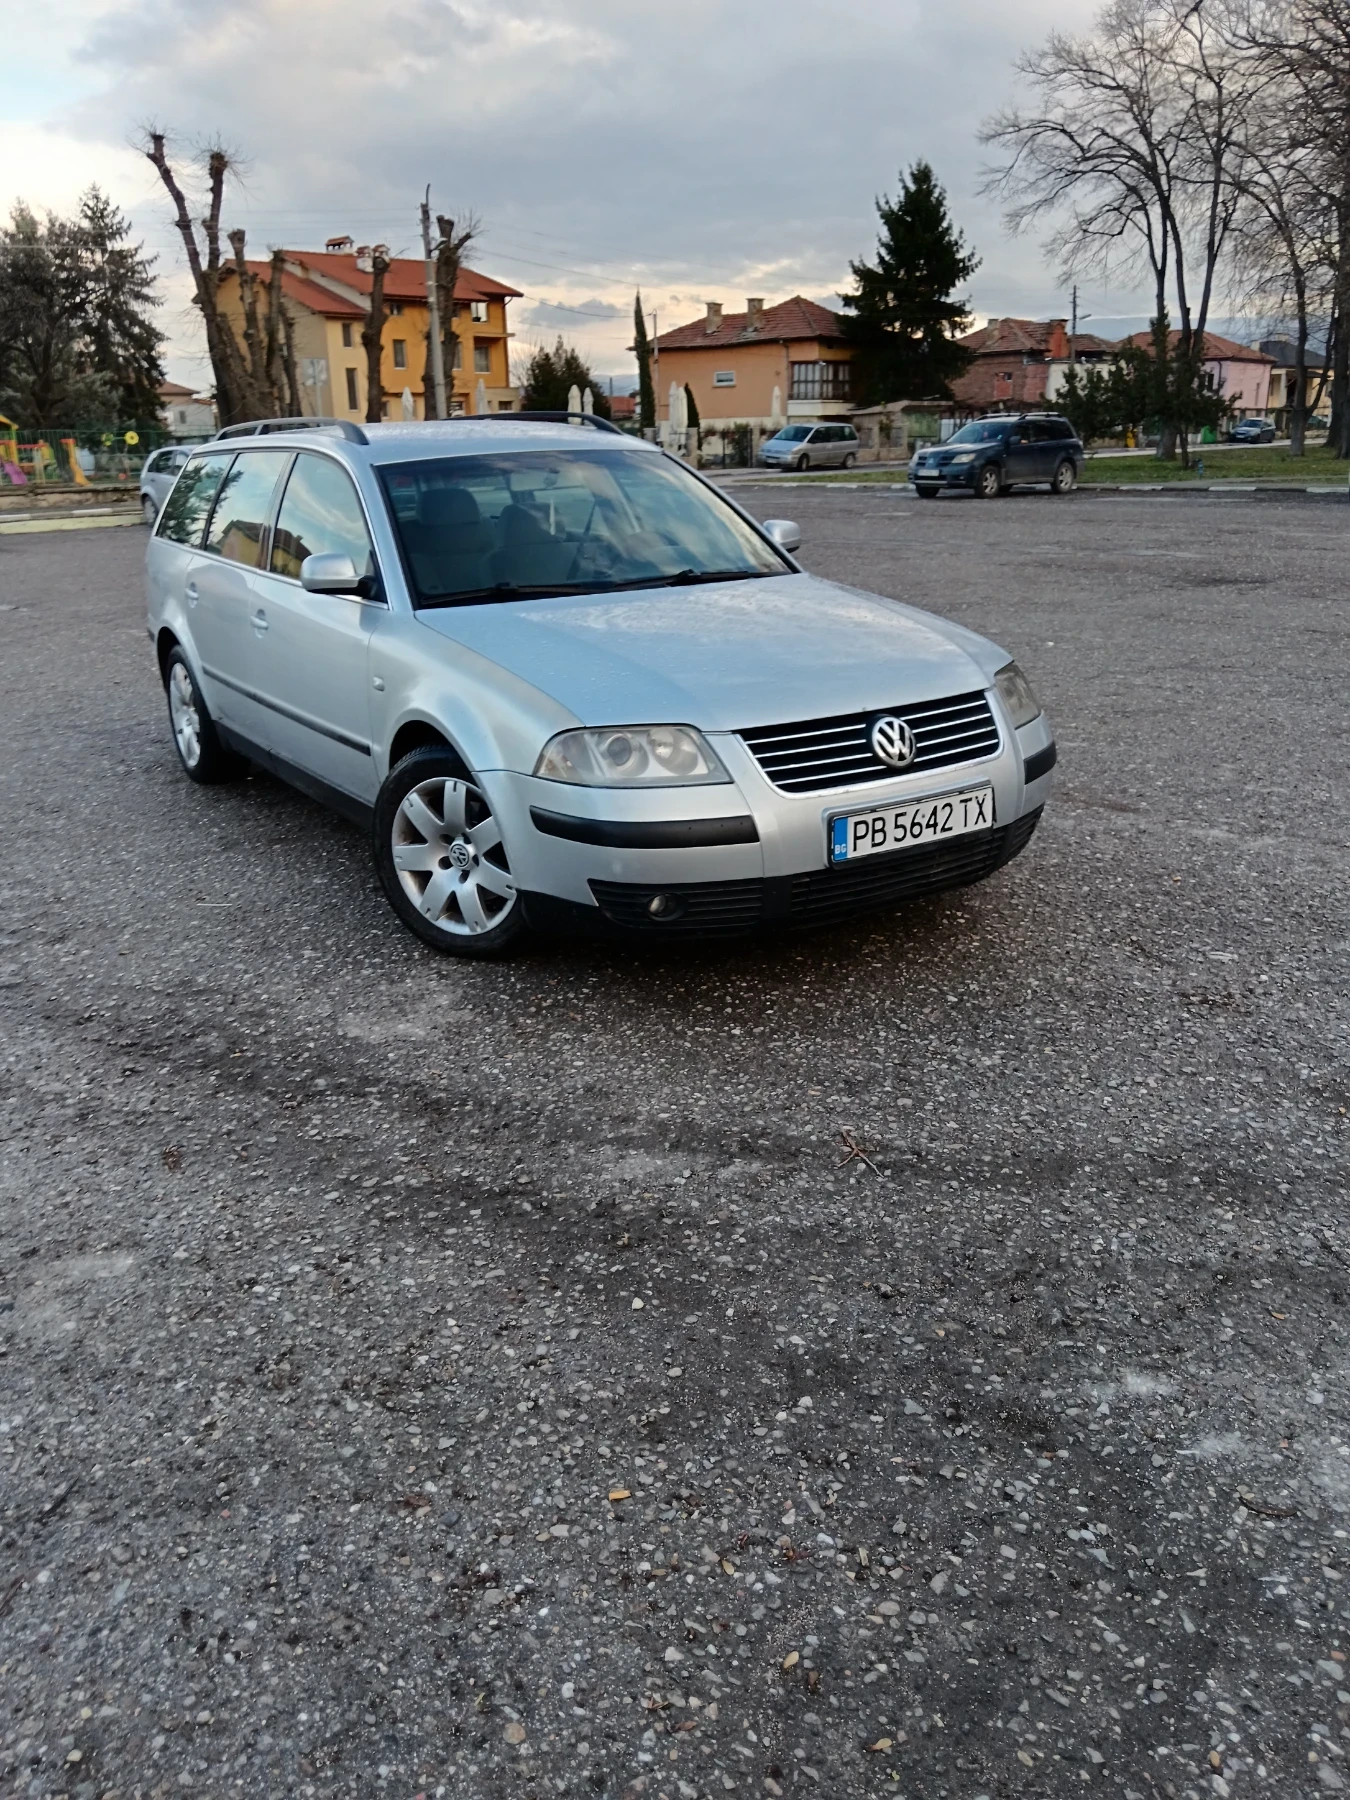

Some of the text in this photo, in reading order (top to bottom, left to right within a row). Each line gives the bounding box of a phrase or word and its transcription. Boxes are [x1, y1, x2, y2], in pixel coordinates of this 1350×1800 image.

[872, 716, 915, 766] VW
[852, 793, 987, 852] PB 5642 TX
[834, 843, 847, 854] BG
